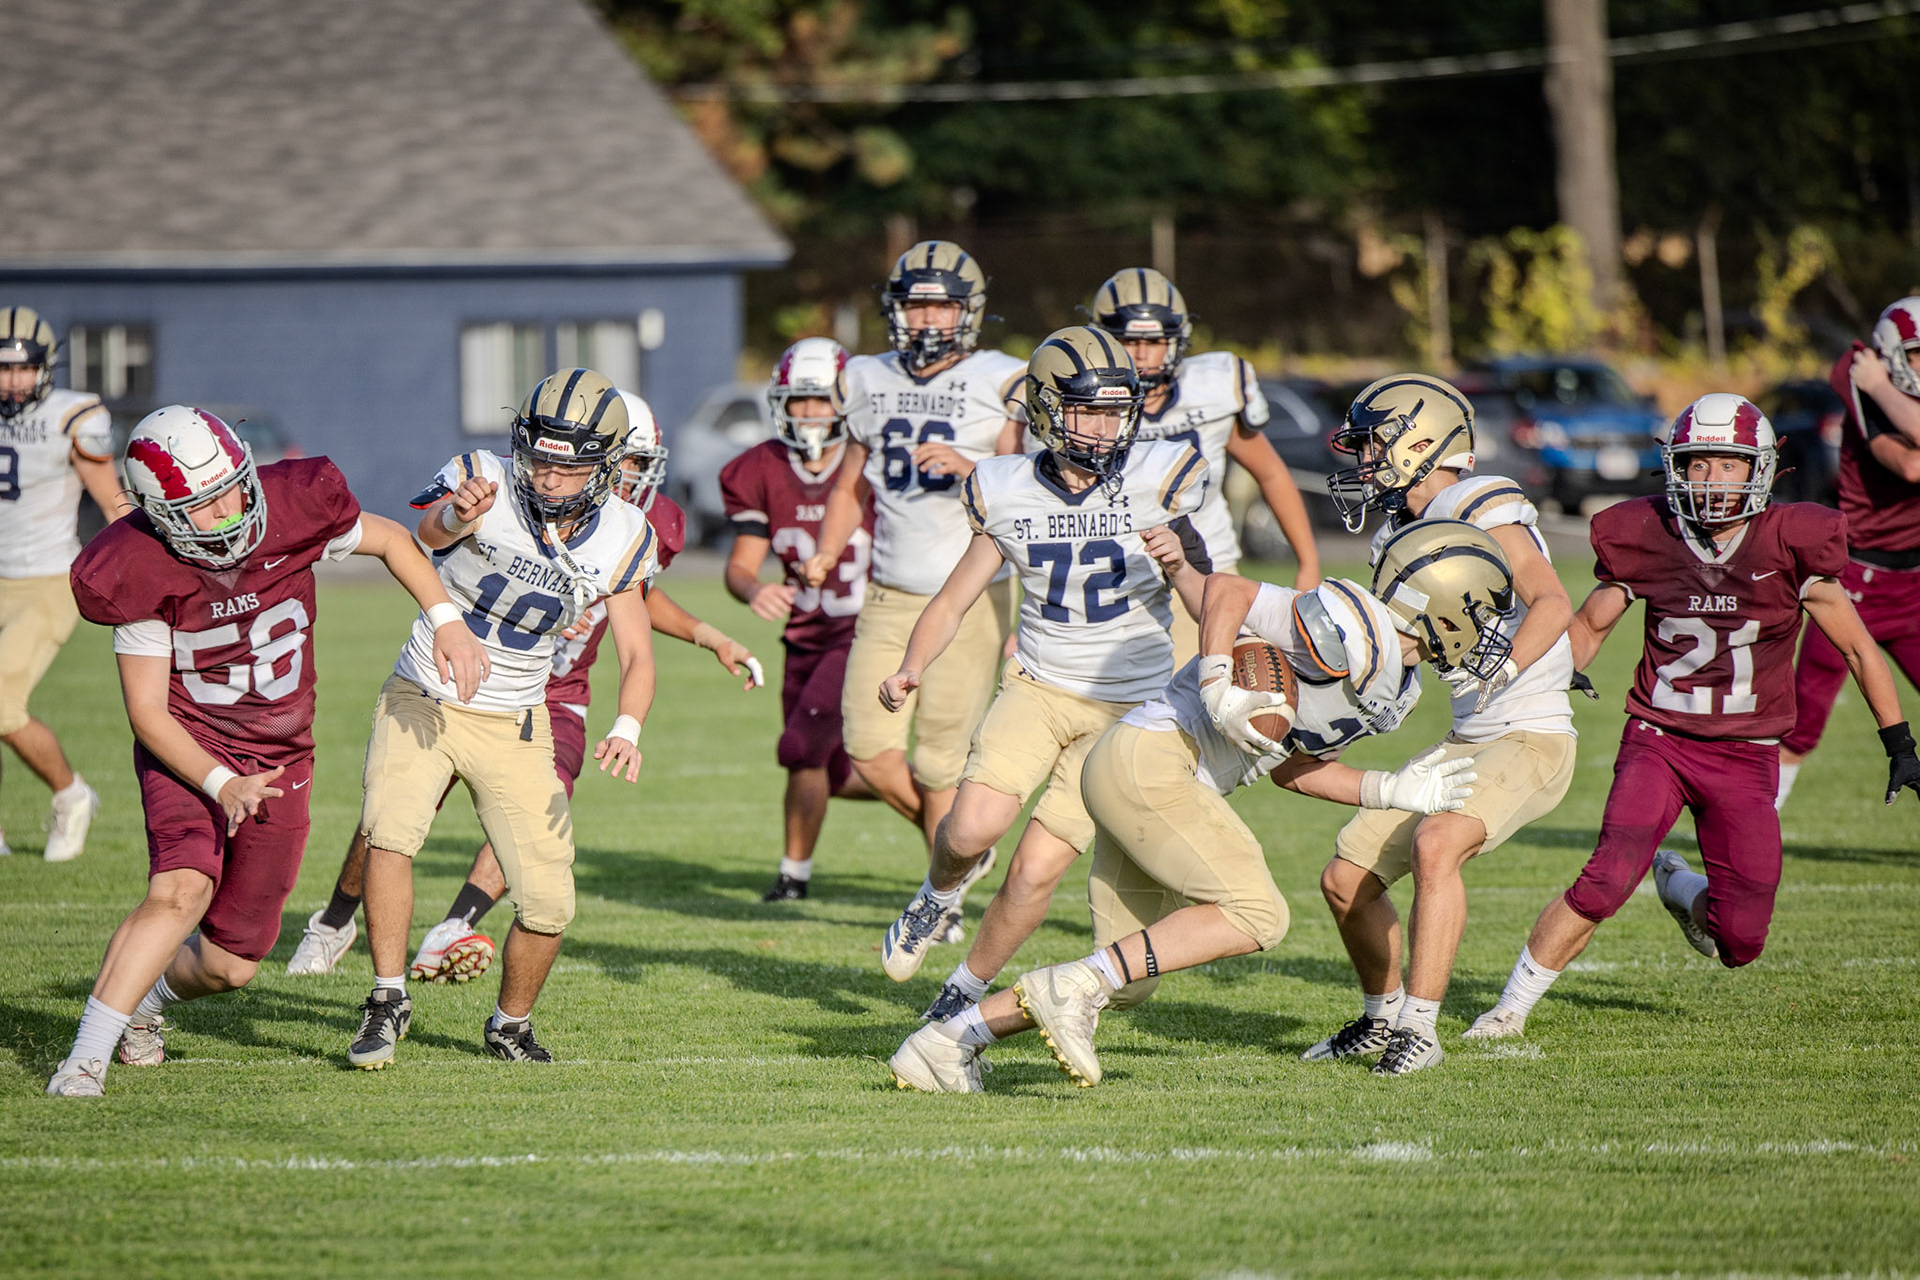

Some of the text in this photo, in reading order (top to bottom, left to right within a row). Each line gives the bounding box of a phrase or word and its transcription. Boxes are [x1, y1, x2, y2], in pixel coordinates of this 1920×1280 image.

[872, 393, 966, 418] ST. BERNARD'S
[539, 439, 570, 451] Riddell
[882, 418, 955, 491] 66
[200, 468, 228, 488] Riddell
[1014, 513, 1132, 539] ST. BERNARD'S
[772, 527, 872, 617] 33
[1027, 539, 1130, 623] 72
[211, 593, 260, 619] RAMS
[462, 572, 563, 651] 10
[1688, 595, 1738, 612] RAMS
[173, 598, 310, 705] 58
[1244, 650, 1258, 688] Wilson
[1651, 616, 1761, 715] 21
